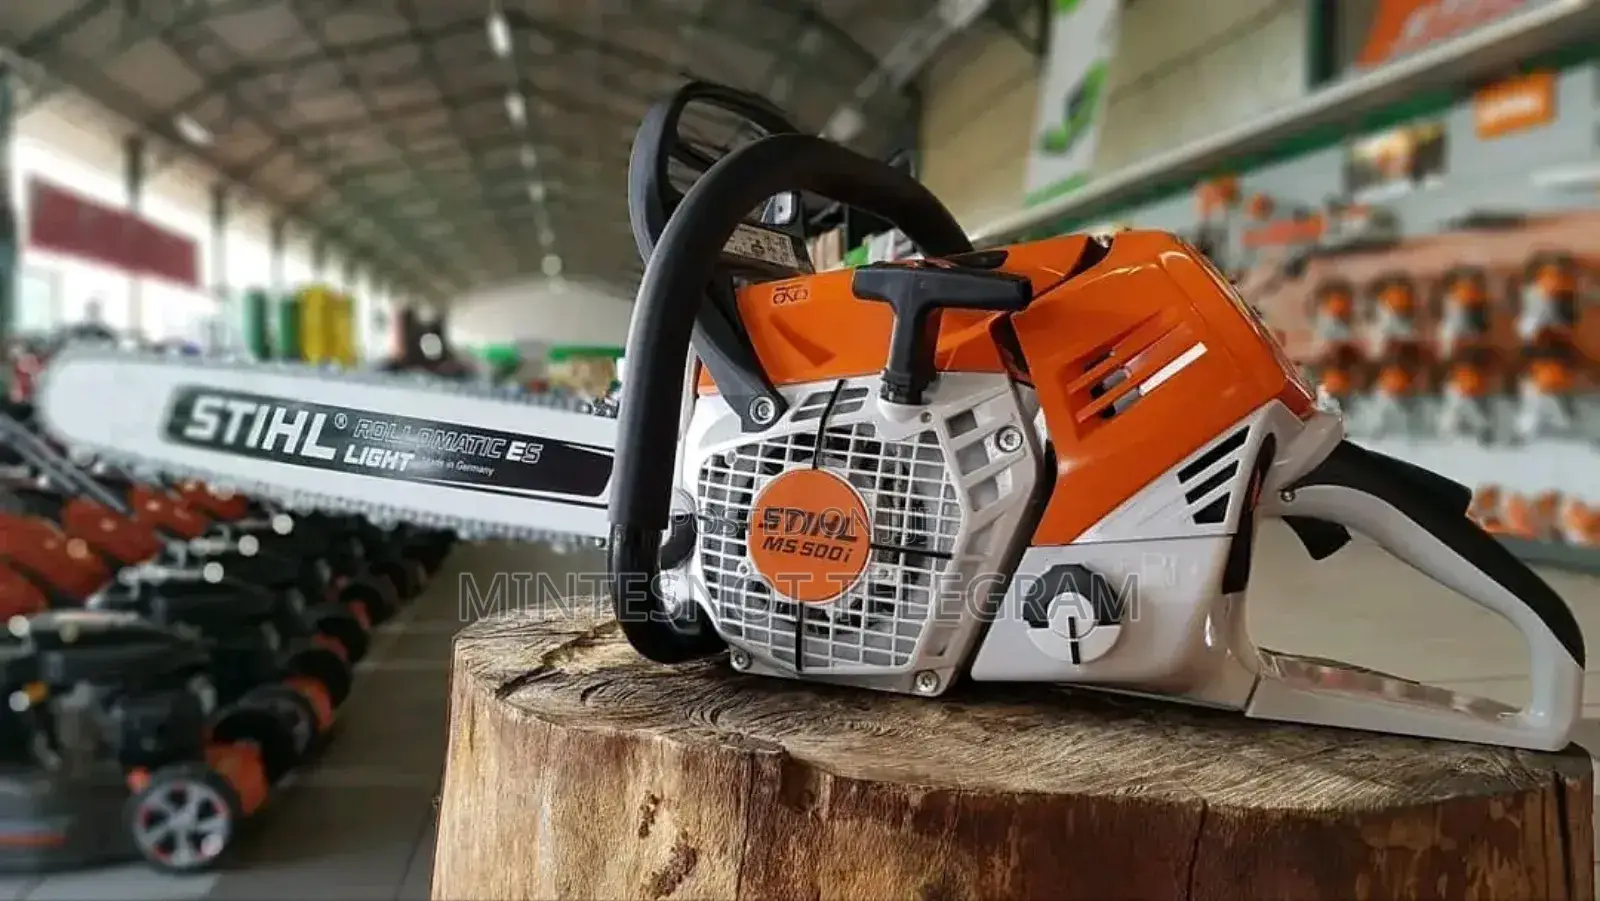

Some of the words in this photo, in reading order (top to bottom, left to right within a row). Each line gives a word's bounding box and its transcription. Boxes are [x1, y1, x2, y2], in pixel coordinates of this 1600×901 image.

[353, 419, 505, 458] ROLLOMATIC
[506, 441, 544, 464] ES
[343, 444, 415, 471] LIGHT
[456, 460, 496, 478] Germany
[759, 507, 859, 542] STIHL
[762, 536, 796, 555] MS
[798, 543, 853, 564] 500i
